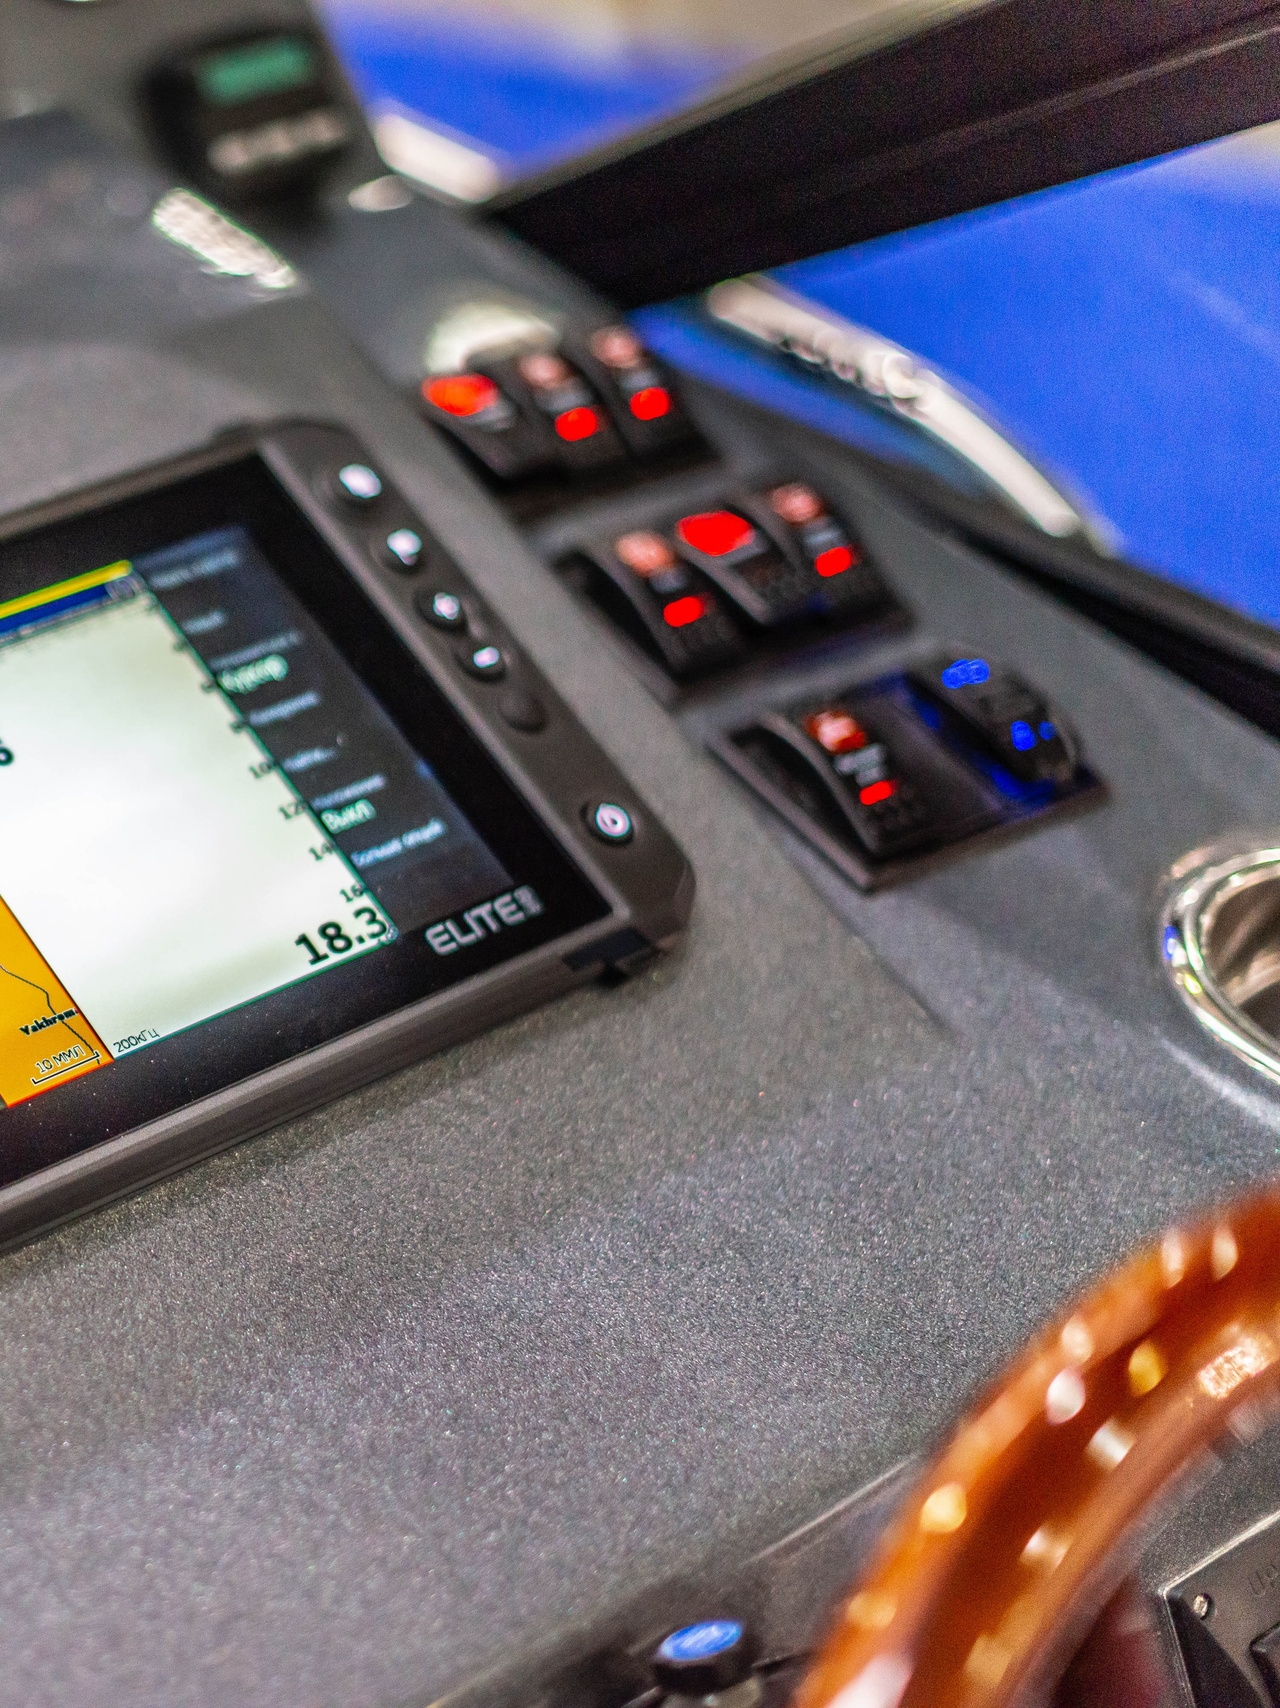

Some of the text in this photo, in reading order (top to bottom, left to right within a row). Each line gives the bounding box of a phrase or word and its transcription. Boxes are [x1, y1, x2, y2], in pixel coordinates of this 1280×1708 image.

[294, 906, 388, 966] 18.3
[424, 890, 526, 956] ELITE
[35, 1058, 54, 1075] 10
